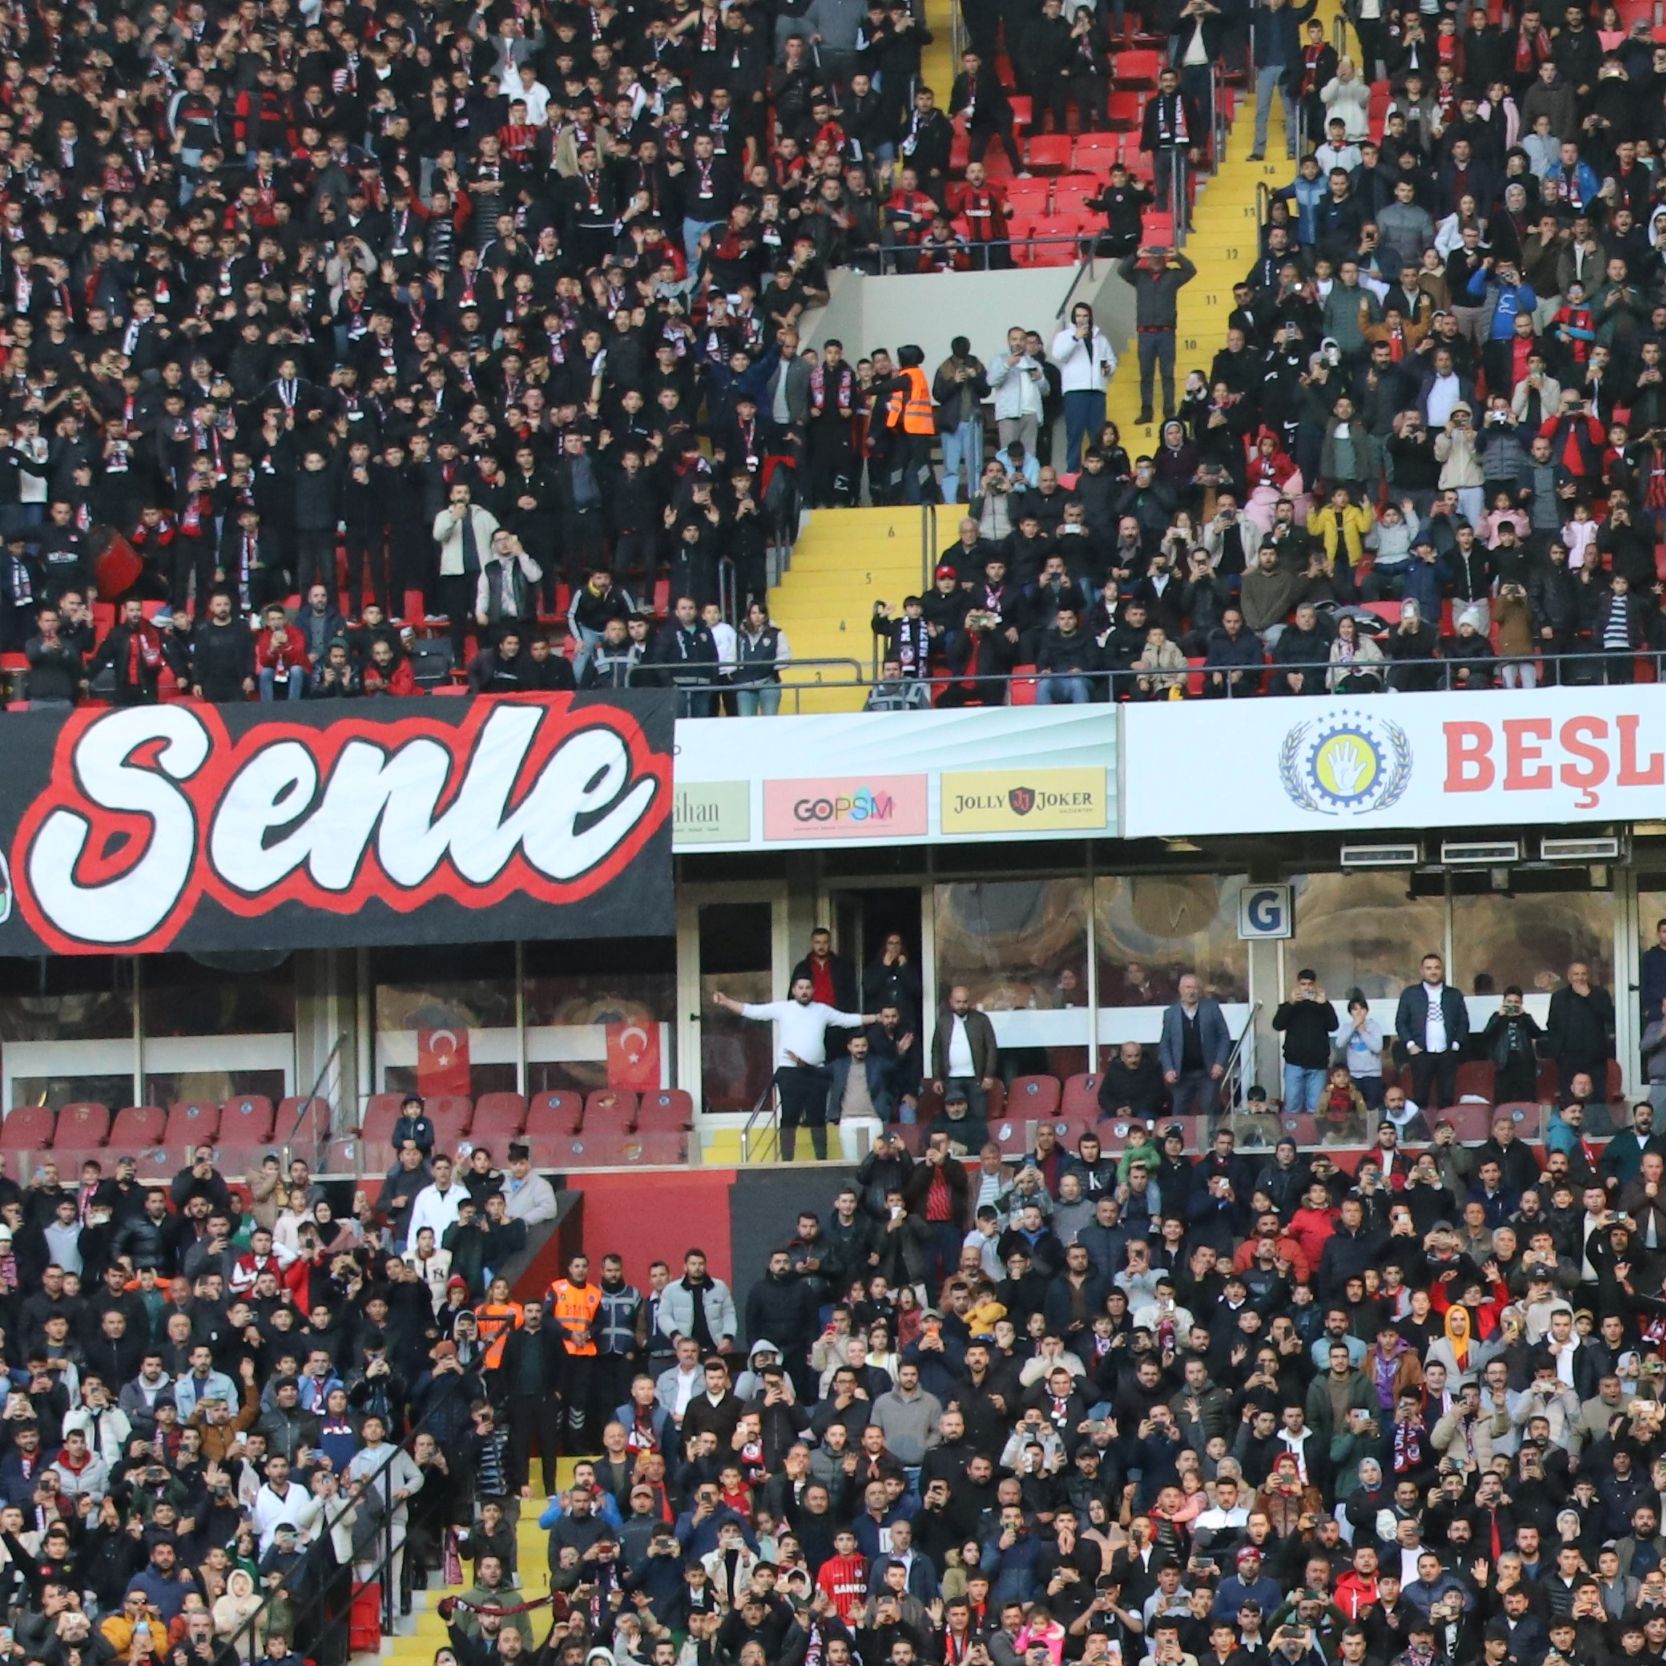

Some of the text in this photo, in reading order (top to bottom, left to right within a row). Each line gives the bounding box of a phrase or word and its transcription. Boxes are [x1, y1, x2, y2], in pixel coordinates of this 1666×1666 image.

[1206, 294, 1217, 306] 11
[889, 525, 896, 540] 6
[865, 573, 872, 586] 5
[954, 793, 1004, 814] JOLLY
[1036, 791, 1093, 812] JOKER
[29, 703, 657, 943] Senle
[1248, 890, 1281, 932] G
